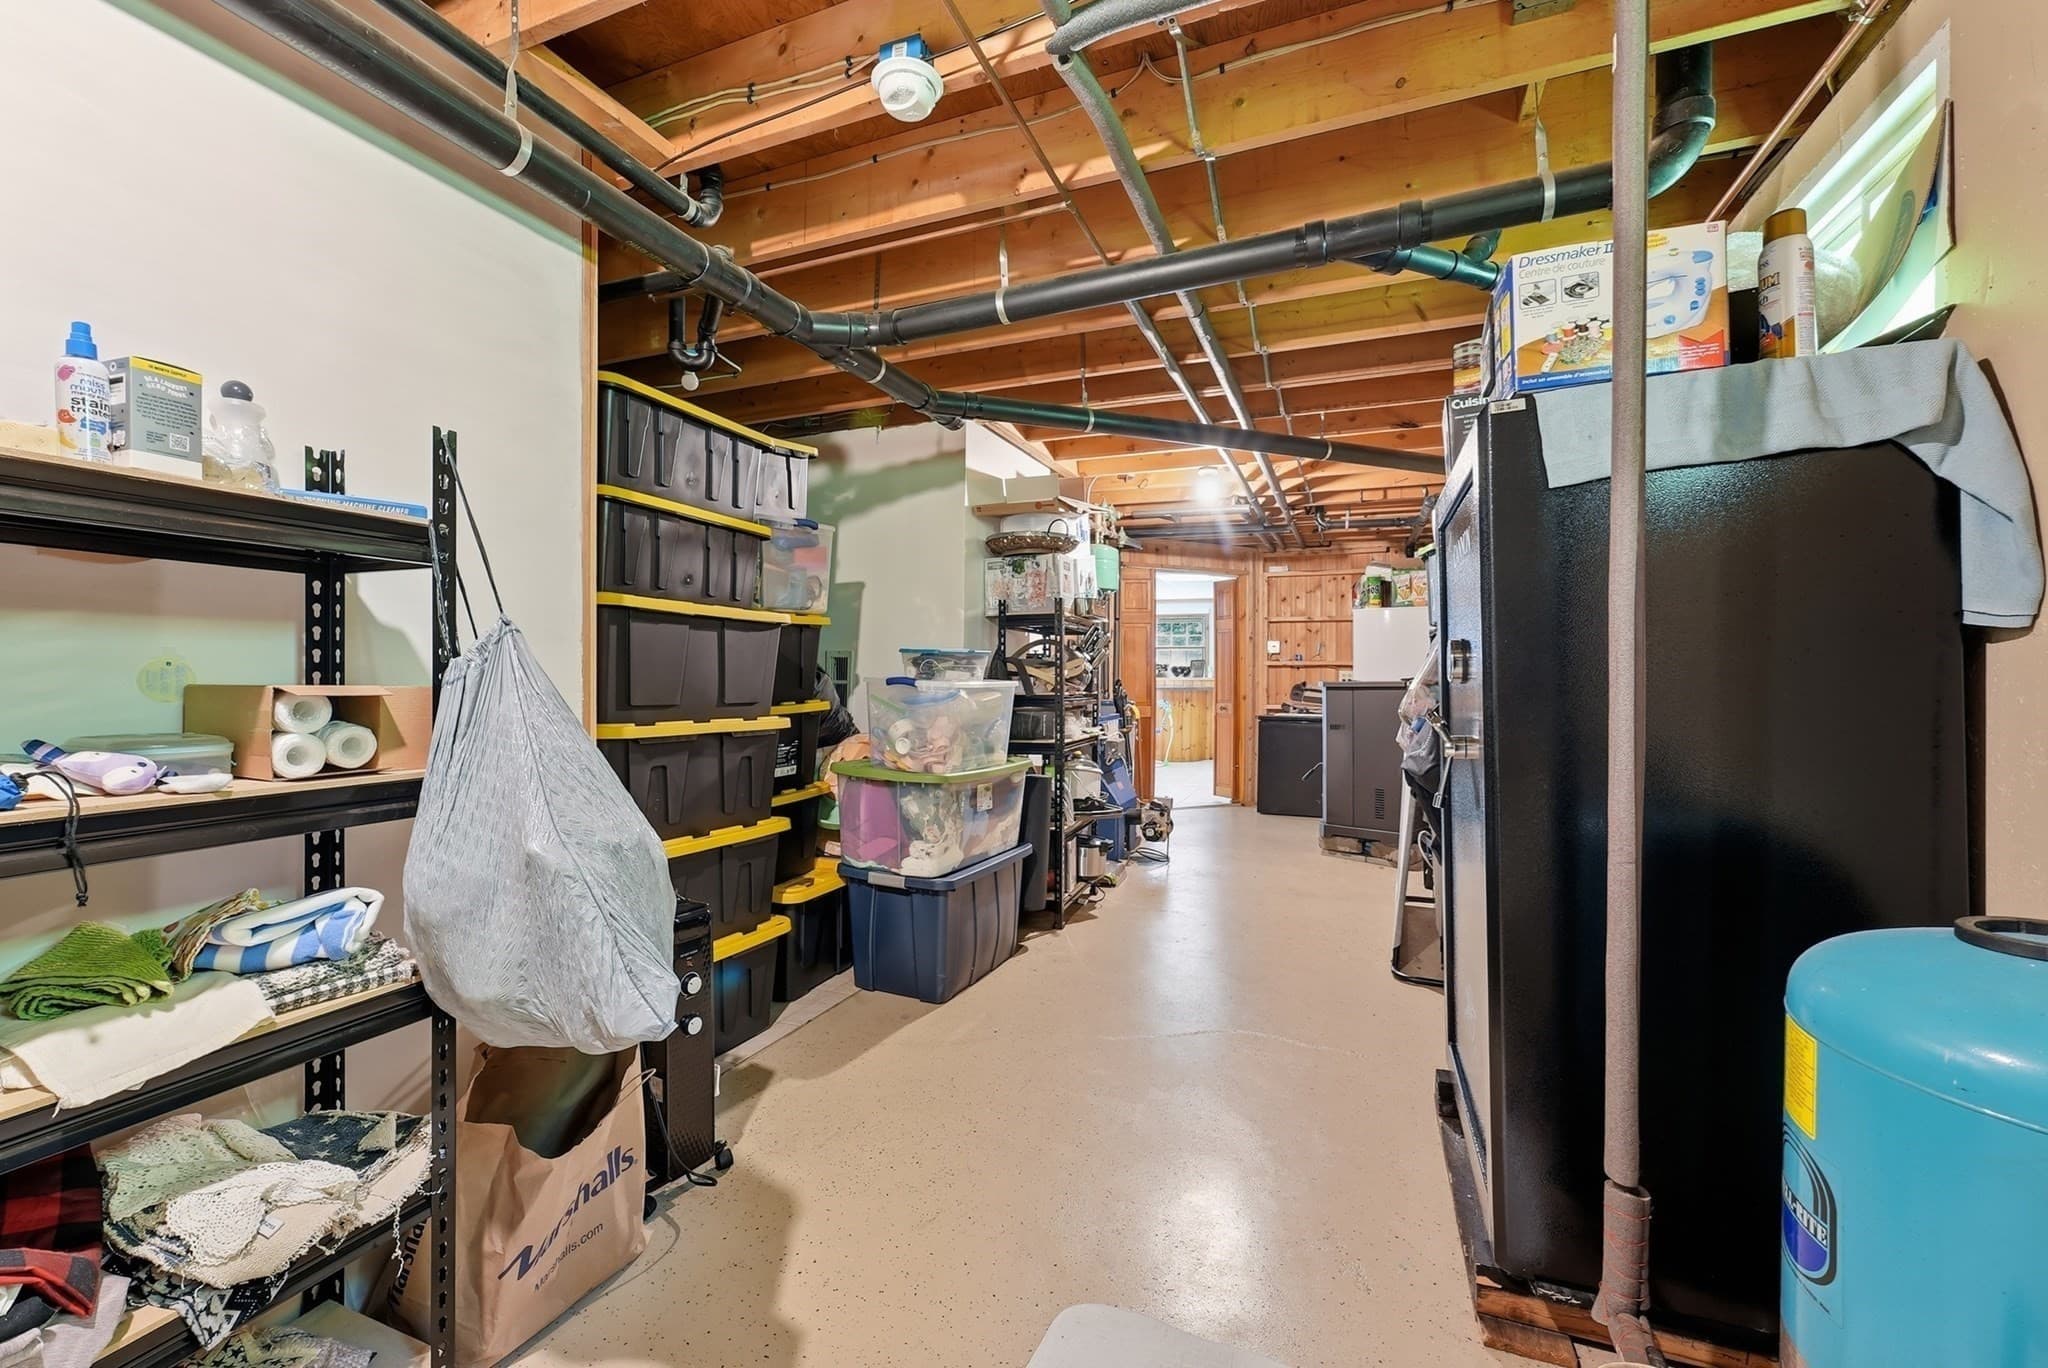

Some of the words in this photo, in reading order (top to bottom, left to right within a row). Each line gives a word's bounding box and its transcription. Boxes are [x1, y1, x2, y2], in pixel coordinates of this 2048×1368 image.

[1519, 246, 1601, 268] Dressmaker
[1519, 266, 1551, 279] Centre
[1552, 265, 1564, 273] de
[1567, 257, 1606, 271] couture
[71, 397, 110, 412] stain
[1452, 397, 1488, 409] Cuisin
[71, 405, 110, 418] treate
[377, 504, 409, 515] CLEANER
